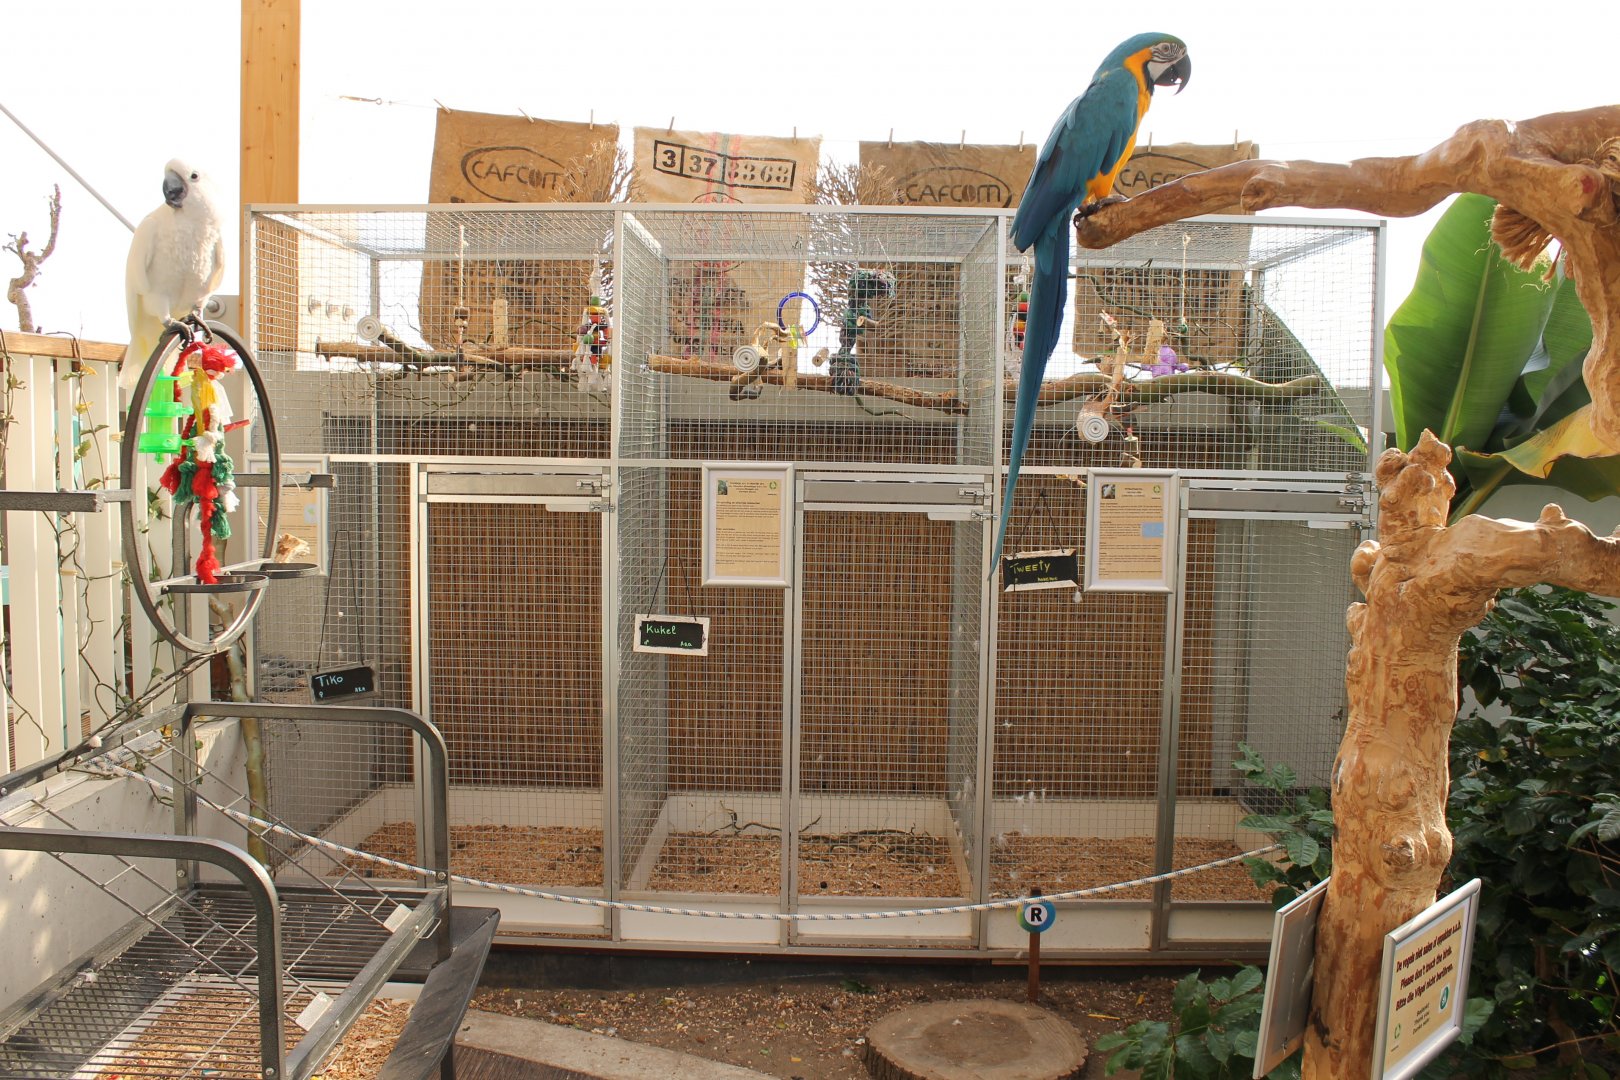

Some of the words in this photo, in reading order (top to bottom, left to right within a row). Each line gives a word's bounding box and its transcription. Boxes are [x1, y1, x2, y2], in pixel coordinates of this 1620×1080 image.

[662, 149, 676, 168] 3
[689, 154, 717, 176] 37
[906, 184, 1001, 202] CAFCOM
[646, 623, 677, 635] Kukel
[1030, 907, 1042, 922] R
[1396, 961, 1402, 973] De
[1402, 952, 1415, 969] vogels
[1415, 946, 1423, 960] niet
[1400, 974, 1414, 990] Please
[1425, 956, 1435, 973] touch
[1396, 997, 1406, 1011] Bitte
[1426, 975, 1436, 989] nicht
